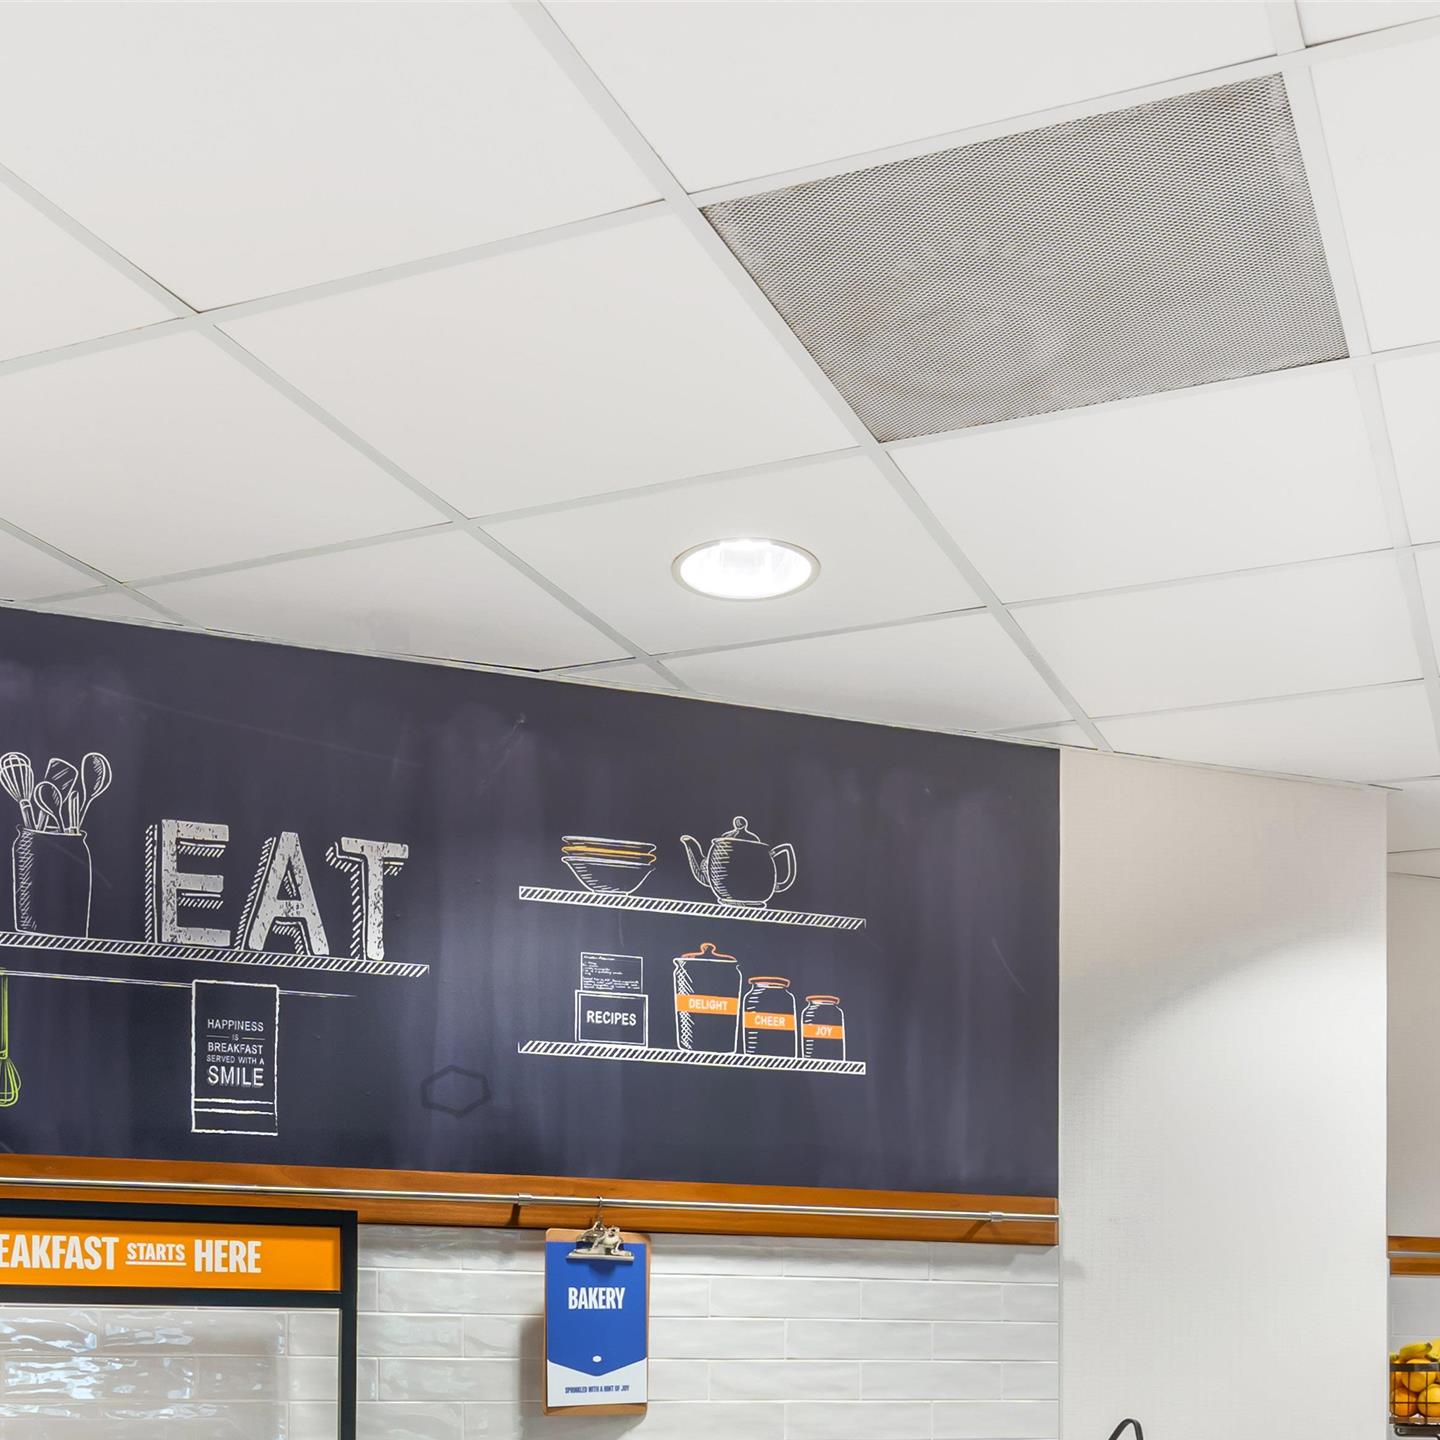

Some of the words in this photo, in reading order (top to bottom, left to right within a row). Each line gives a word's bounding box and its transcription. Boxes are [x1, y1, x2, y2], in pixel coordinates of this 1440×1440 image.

[145, 818, 409, 961] EAT
[688, 998, 728, 1011] DELIGHT
[586, 1010, 637, 1026] RECIPES
[754, 1014, 785, 1027] CHEER
[207, 1019, 264, 1032] HAPPINESS
[815, 1026, 832, 1036] JOY
[208, 1042, 264, 1055] BREAKFAST
[206, 1054, 236, 1064] SERVED
[238, 1056, 257, 1065] WITH
[207, 1065, 264, 1087] SMILE
[126, 1241, 186, 1263] STARTS
[194, 1238, 262, 1274] HERE
[568, 1287, 626, 1310] BAKERY
